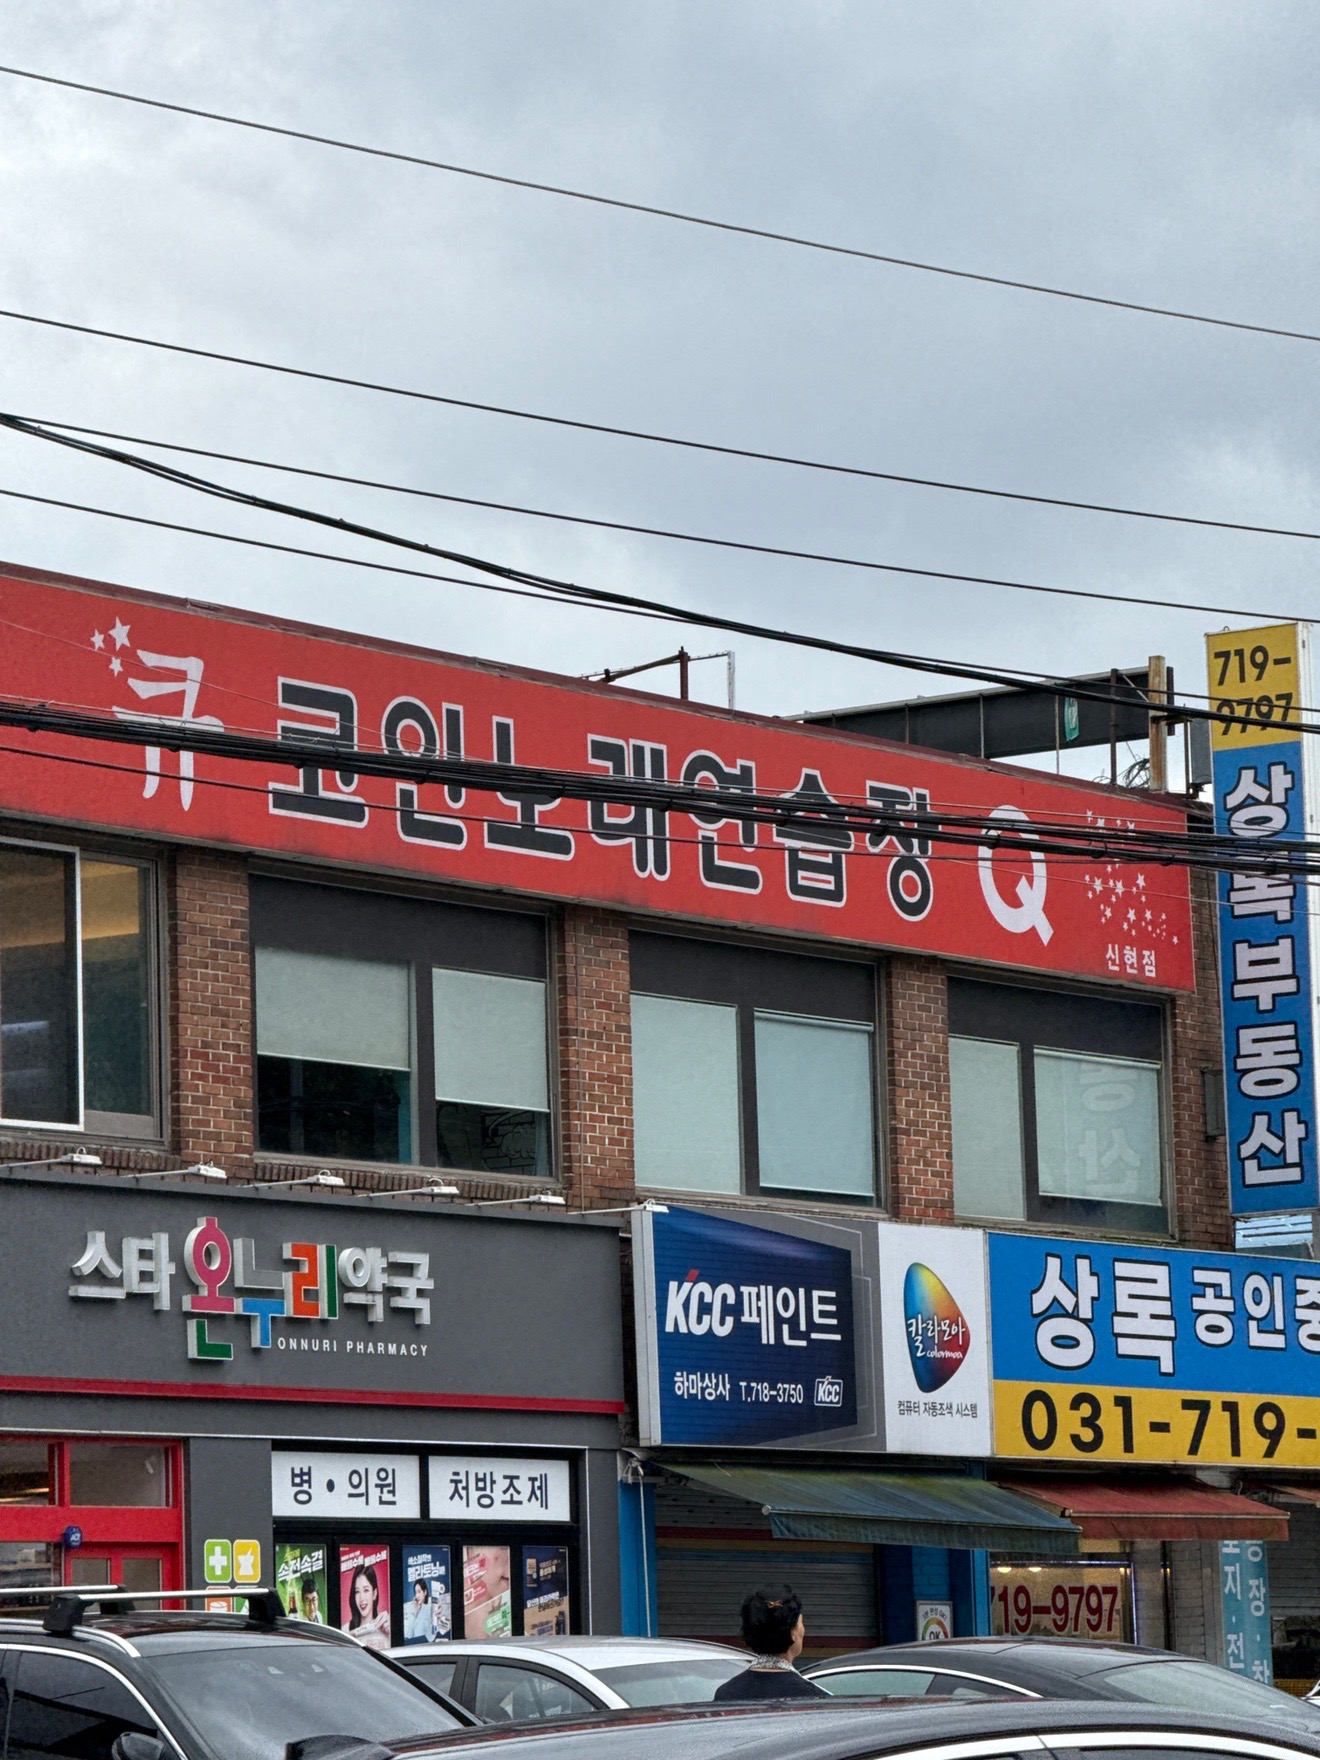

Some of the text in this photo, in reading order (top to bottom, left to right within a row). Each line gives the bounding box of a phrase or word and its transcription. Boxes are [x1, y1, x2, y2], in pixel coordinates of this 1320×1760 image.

[1213, 645, 1292, 687] 719-
[978, 805, 1054, 946] Q
[1105, 943, 1158, 978] 신현점
[665, 1269, 842, 1347] KCC 페인트
[1030, 1252, 1177, 1377] 상록
[277, 1336, 429, 1357] ONNURI PHARMACY
[907, 1313, 966, 1357] 칼라모아
[673, 1371, 731, 1401] 하마상사
[817, 1376, 841, 1403] KCC
[897, 1400, 978, 1418] 컴퓨터 자동조색 시스템
[449, 1469, 549, 1510] 처방조제
